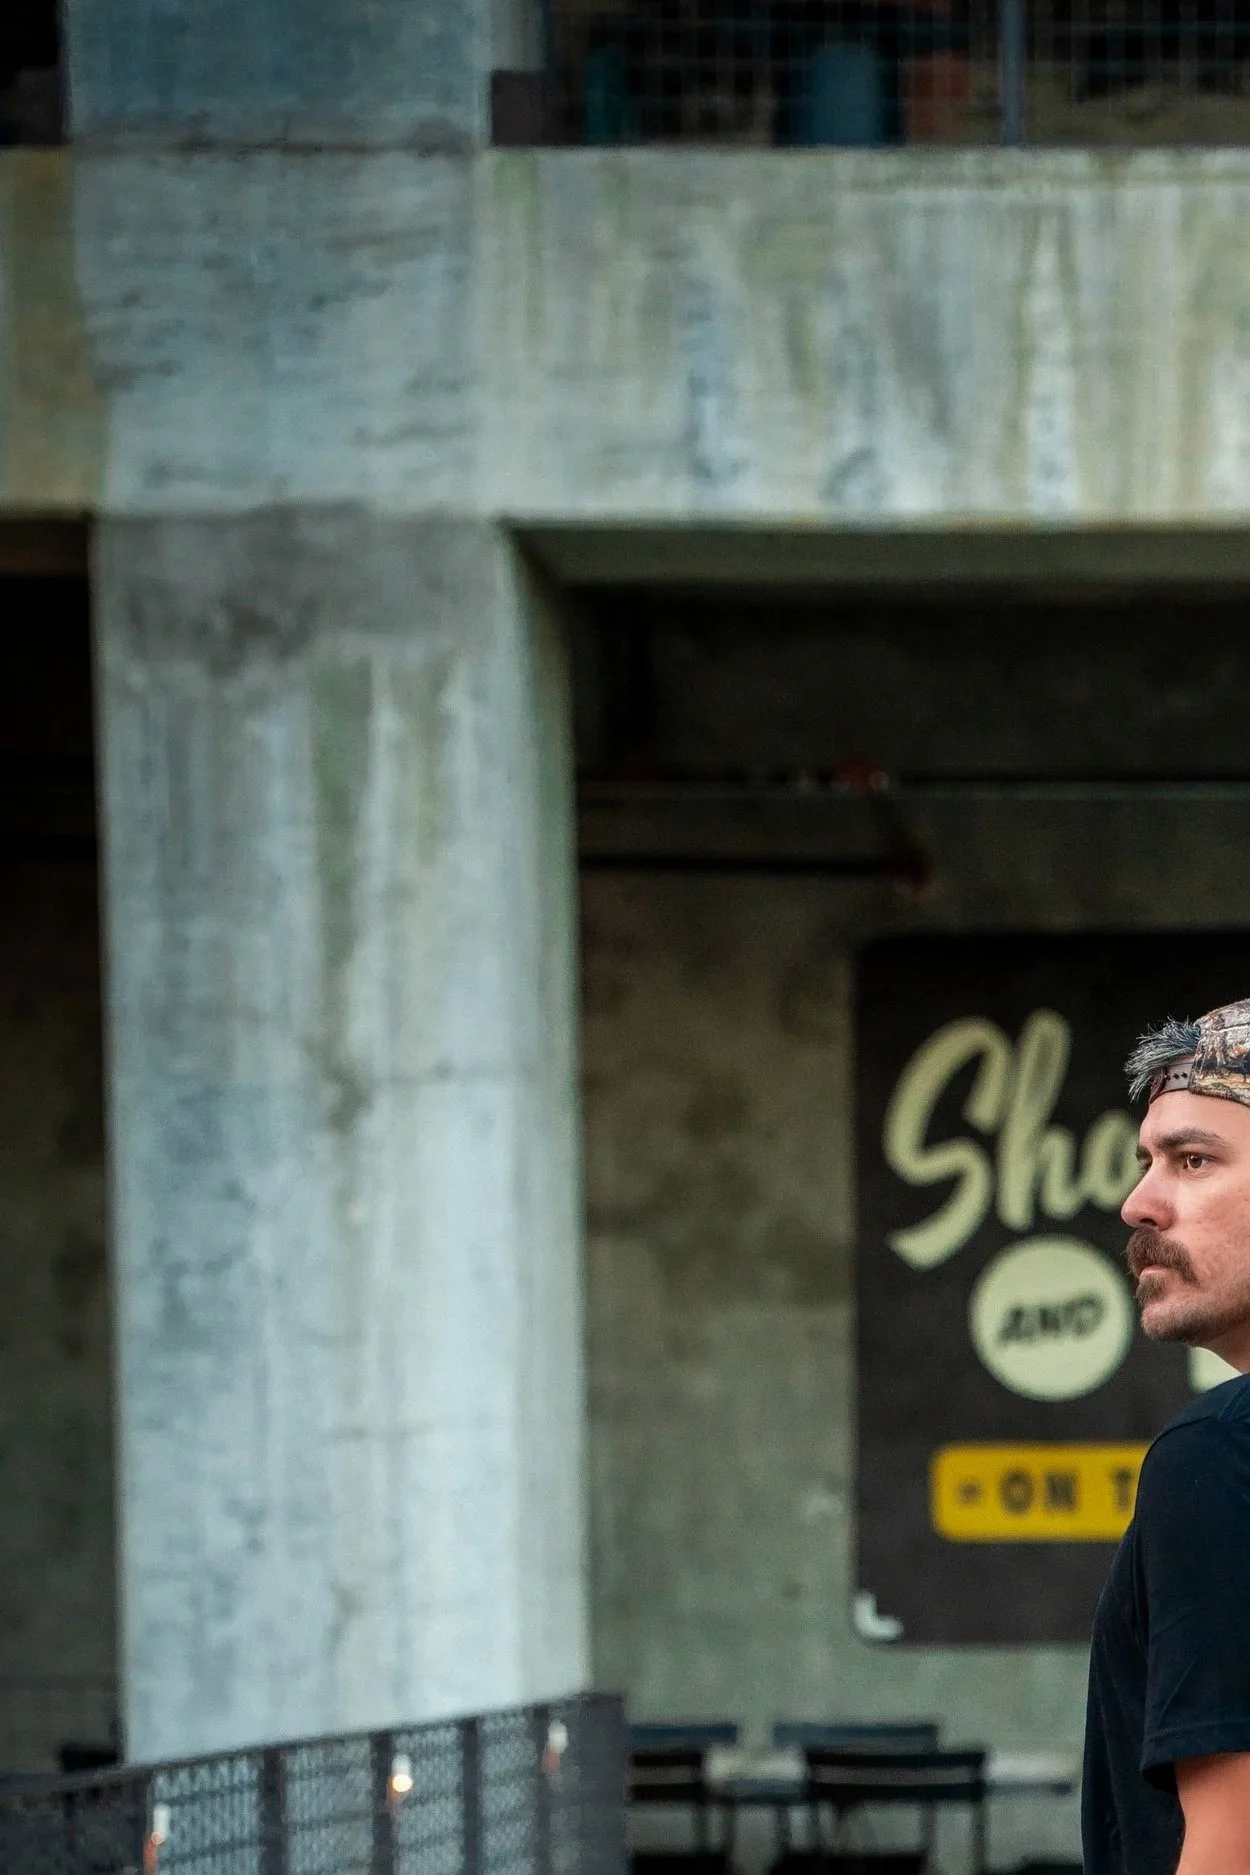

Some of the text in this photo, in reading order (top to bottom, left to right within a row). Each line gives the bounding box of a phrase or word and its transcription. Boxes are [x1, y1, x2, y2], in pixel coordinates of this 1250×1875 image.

[883, 1007, 1142, 1269] Sho
[997, 1291, 1107, 1347] AND
[1000, 1468, 1078, 1514] ON
